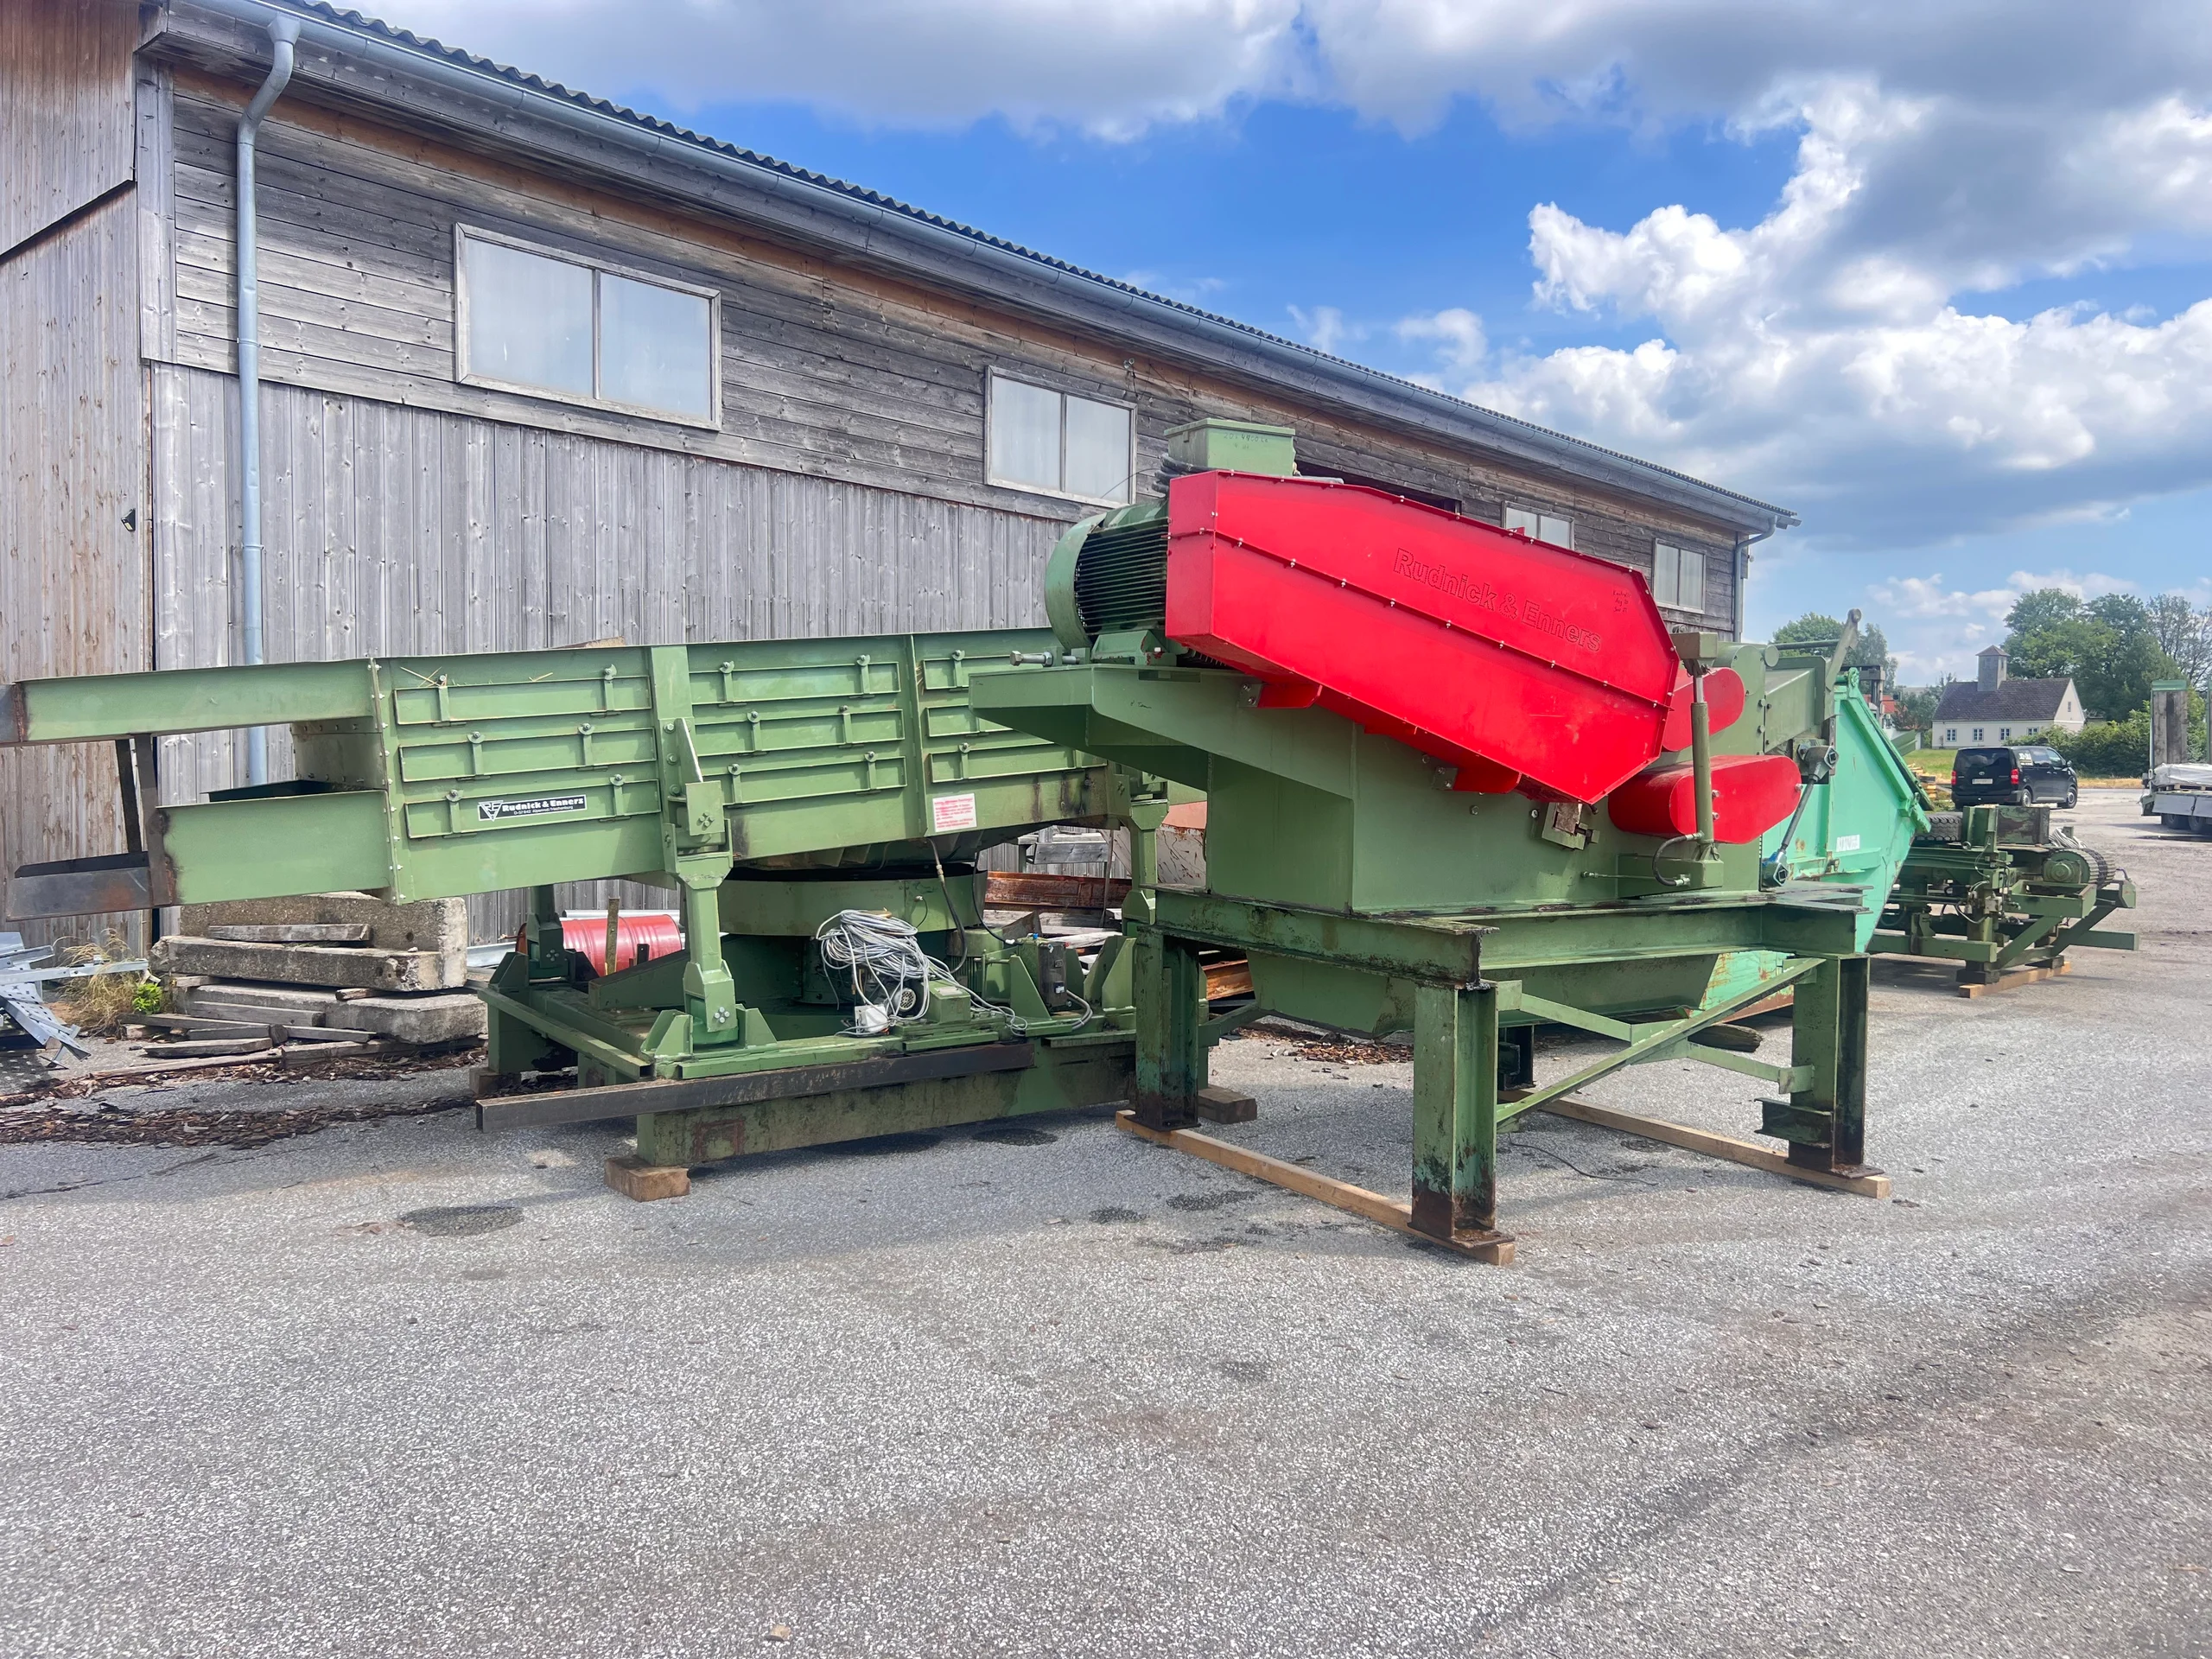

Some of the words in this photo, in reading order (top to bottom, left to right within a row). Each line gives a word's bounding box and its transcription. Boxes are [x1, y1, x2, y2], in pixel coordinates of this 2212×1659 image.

[1393, 548, 1497, 611] Rudnick
[1499, 593, 1517, 619] &
[1521, 600, 1601, 652] Enners
[502, 801, 542, 812] Rudnick
[550, 798, 584, 807] Enners
